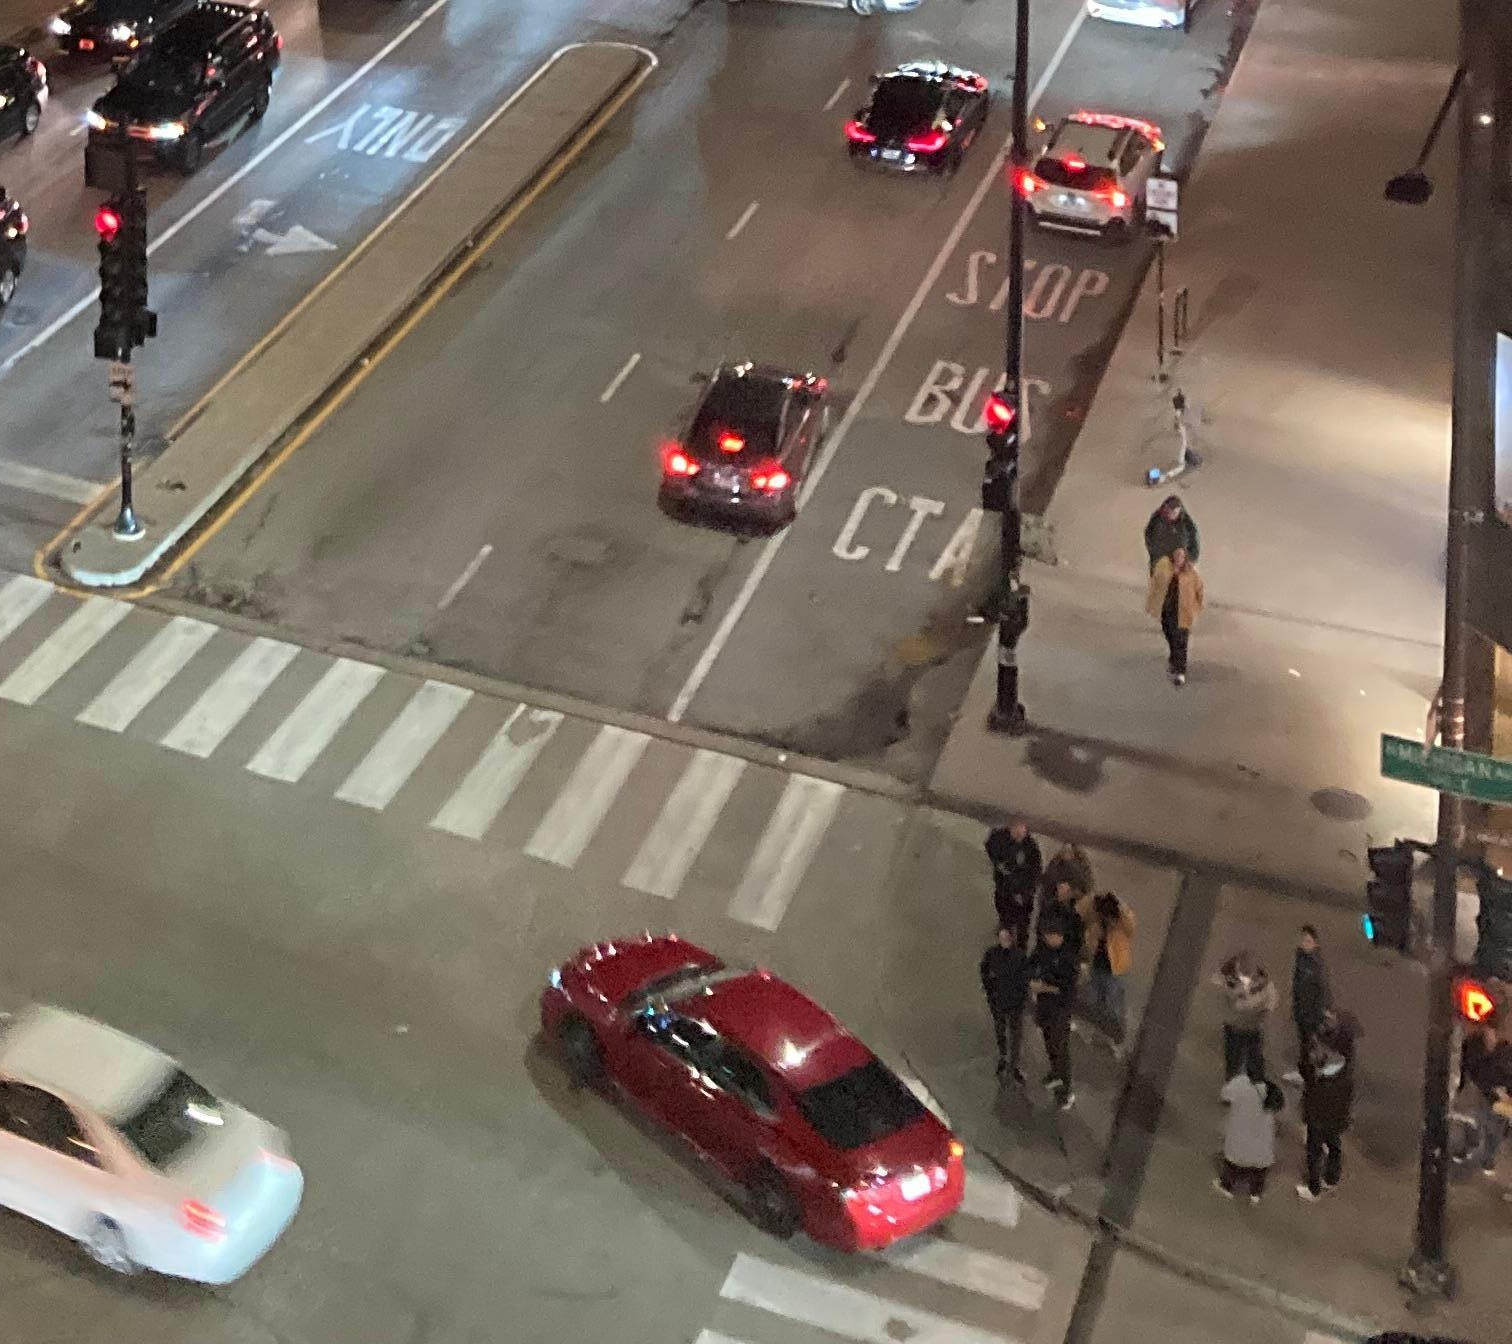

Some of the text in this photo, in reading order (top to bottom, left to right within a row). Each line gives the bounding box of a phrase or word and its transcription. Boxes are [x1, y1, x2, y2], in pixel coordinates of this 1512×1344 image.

[304, 103, 467, 162] ONLY
[946, 251, 1109, 323] STOP
[833, 487, 984, 585] CTA
